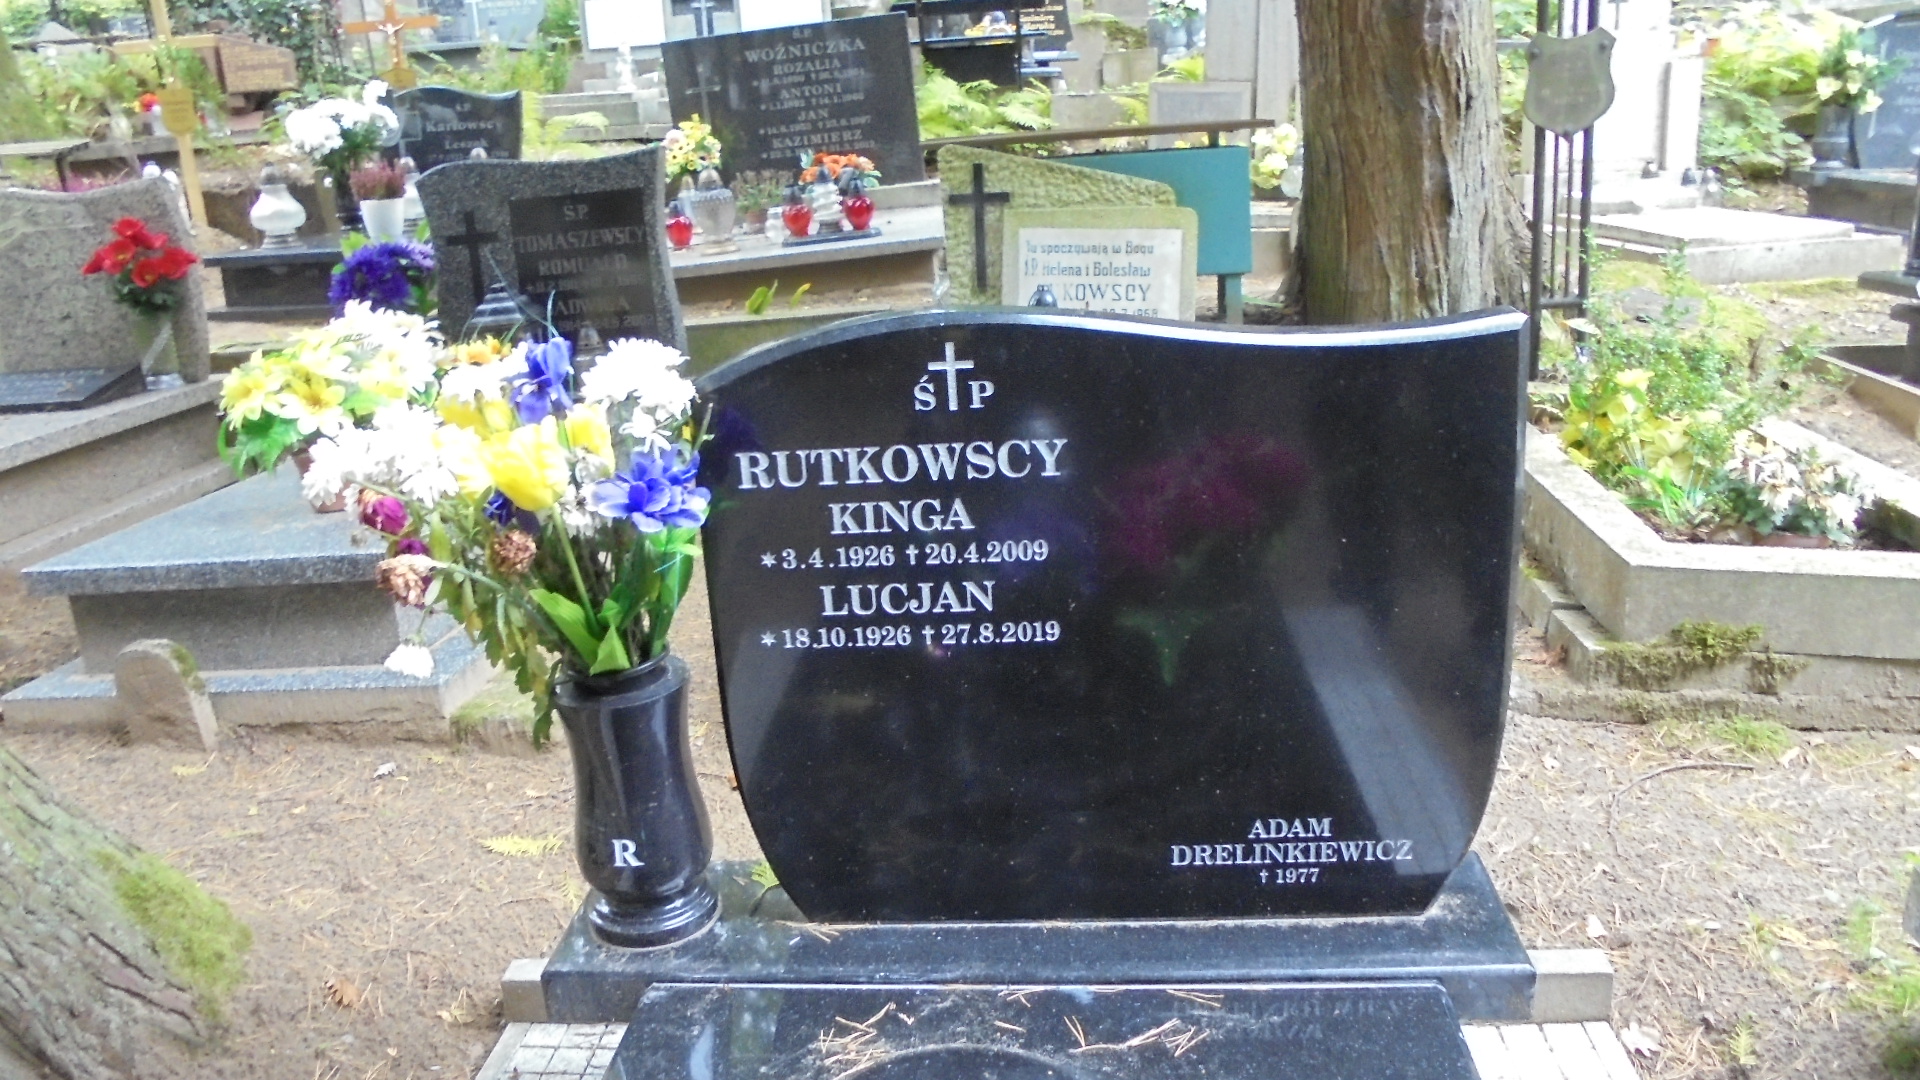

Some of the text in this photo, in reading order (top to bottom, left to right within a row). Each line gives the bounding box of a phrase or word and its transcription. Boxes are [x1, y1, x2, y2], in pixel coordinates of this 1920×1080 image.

[745, 38, 865, 62] WOŹNICZKA
[773, 58, 842, 76] ROZALIA
[780, 82, 842, 100] ANTONI
[798, 108, 829, 121] JAN
[772, 128, 863, 148] KAZIMIERZ
[514, 226, 647, 253] TOMASZEWSCY
[1125, 241, 1154, 255] Bogu
[1042, 261, 1082, 276] Helena
[1093, 261, 1151, 277] Bolesław
[734, 438, 1068, 490] RUTKOWSCY
[828, 498, 976, 534] KINGA
[818, 580, 996, 616] LUCJAN
[1248, 817, 1333, 838] ADAM
[611, 838, 646, 867] R
[1170, 839, 1414, 866] DRELINKIEWICZ
[1276, 868, 1320, 884] 1977
